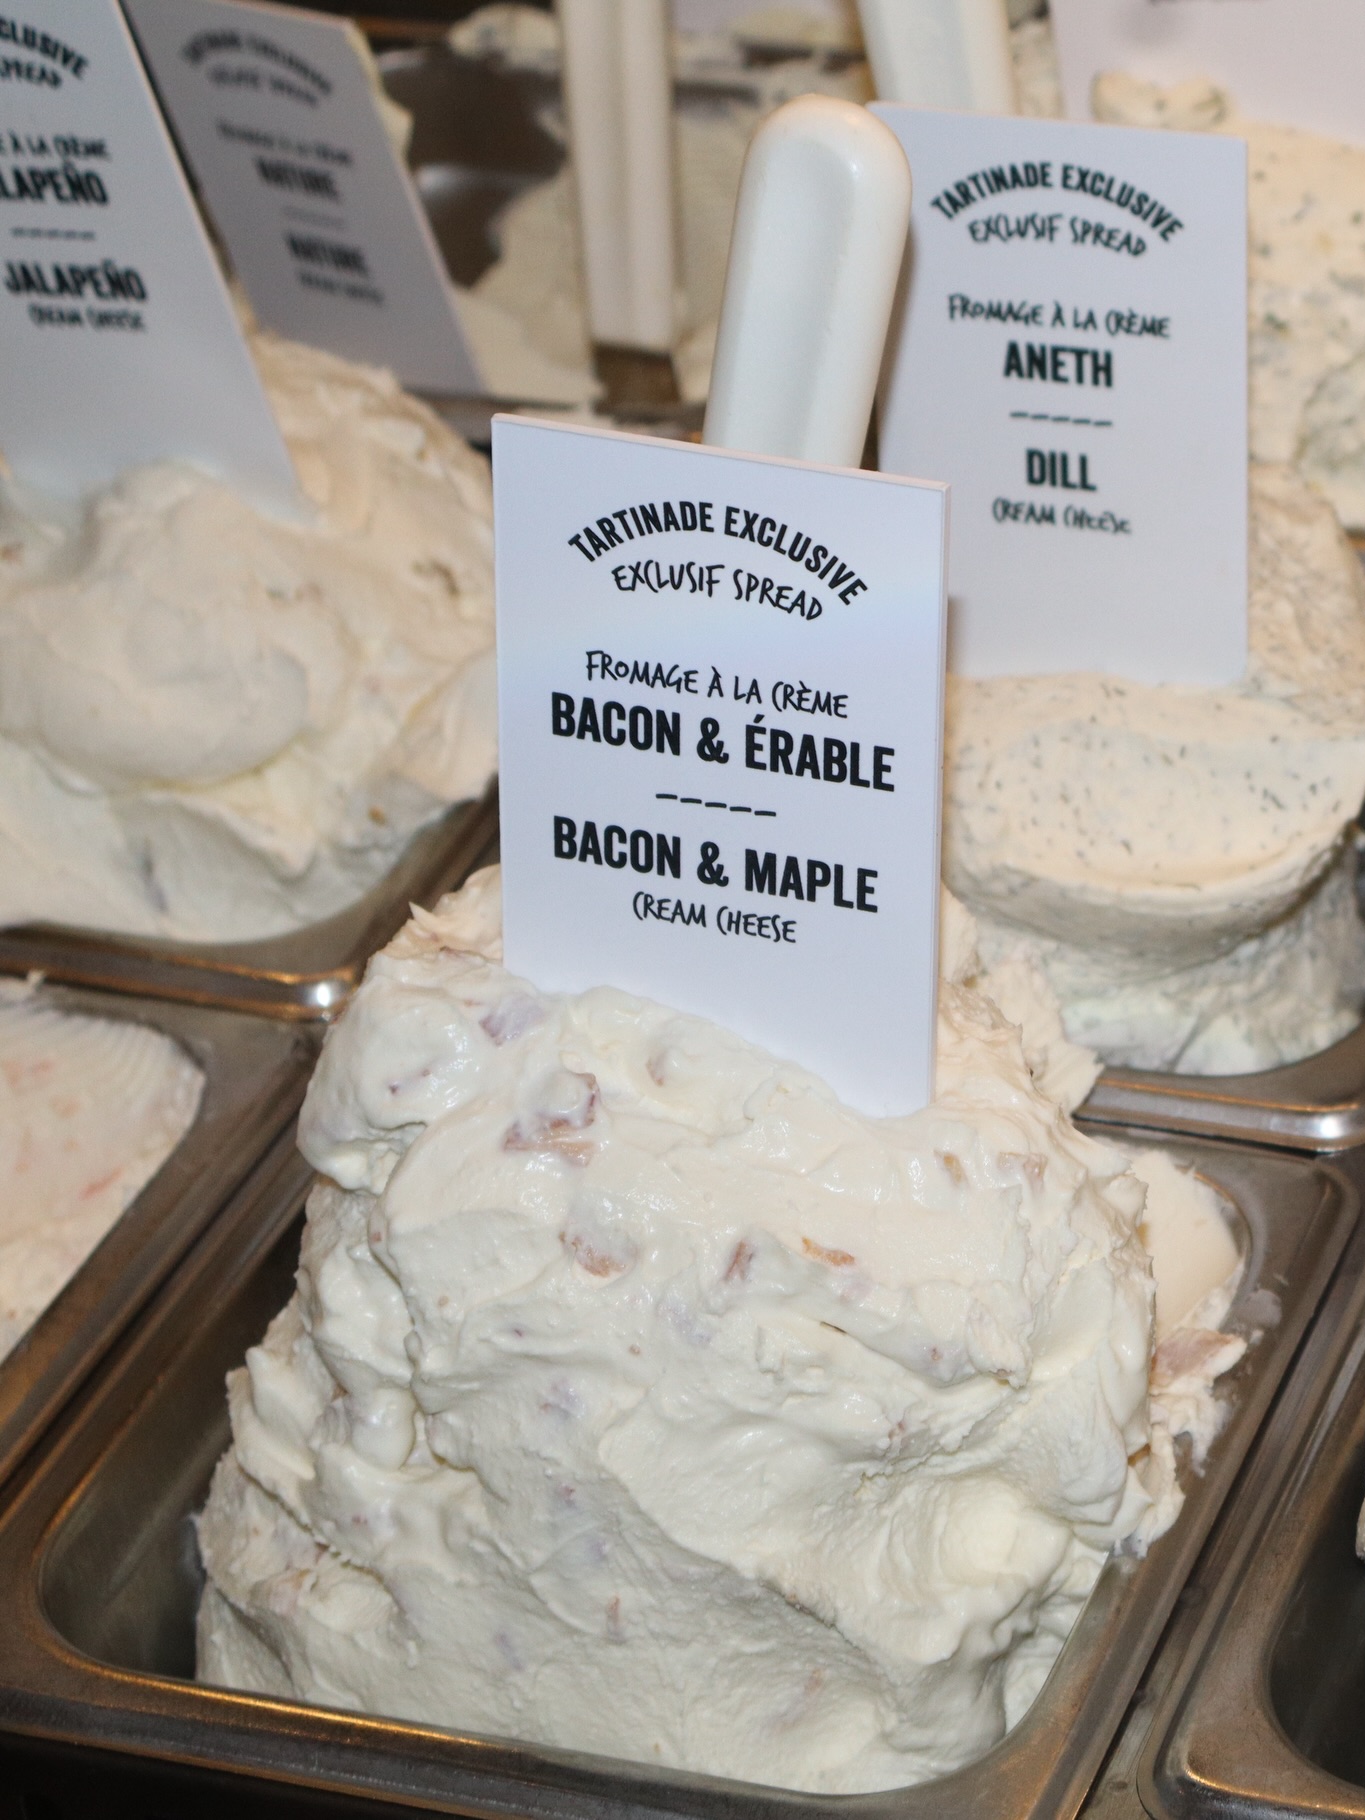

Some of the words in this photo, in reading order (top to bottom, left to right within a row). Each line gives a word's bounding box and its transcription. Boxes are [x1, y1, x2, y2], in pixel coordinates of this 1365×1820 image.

[0, 15, 89, 80] CLUSIVE
[0, 159, 109, 206] LAPEÑO
[930, 161, 1053, 221] TARTINADE
[1060, 163, 1184, 243] EXCLUSIVE
[967, 212, 1063, 244] EXCLUSIF
[1069, 216, 1148, 258] SPREAD
[4, 259, 148, 302] JALAPEÑO
[947, 293, 1043, 326] FROMAGE
[1051, 301, 1066, 328] À
[1072, 308, 1098, 331] LA
[1104, 309, 1170, 339] CRÈME
[1002, 340, 1114, 388] ANETH
[1025, 447, 1098, 493] DILL
[992, 497, 1056, 526] CREAM
[567, 501, 715, 563] TARTINADE
[723, 505, 869, 606] EXCLUSIVE
[610, 559, 726, 599] EXCLUSIF
[732, 568, 823, 621] SPREAD
[585, 649, 699, 695] FROMAGE
[706, 665, 725, 699] À
[733, 675, 763, 705] LA
[771, 680, 849, 719] CRÈME
[551, 691, 681, 757] BACON
[696, 716, 730, 765] &
[744, 713, 895, 793] ÉRABLE
[553, 815, 682, 880] BACON
[696, 840, 730, 888] &
[744, 848, 879, 914] MAPLE
[632, 890, 707, 929] CREAM
[716, 905, 798, 945] CHEESE
